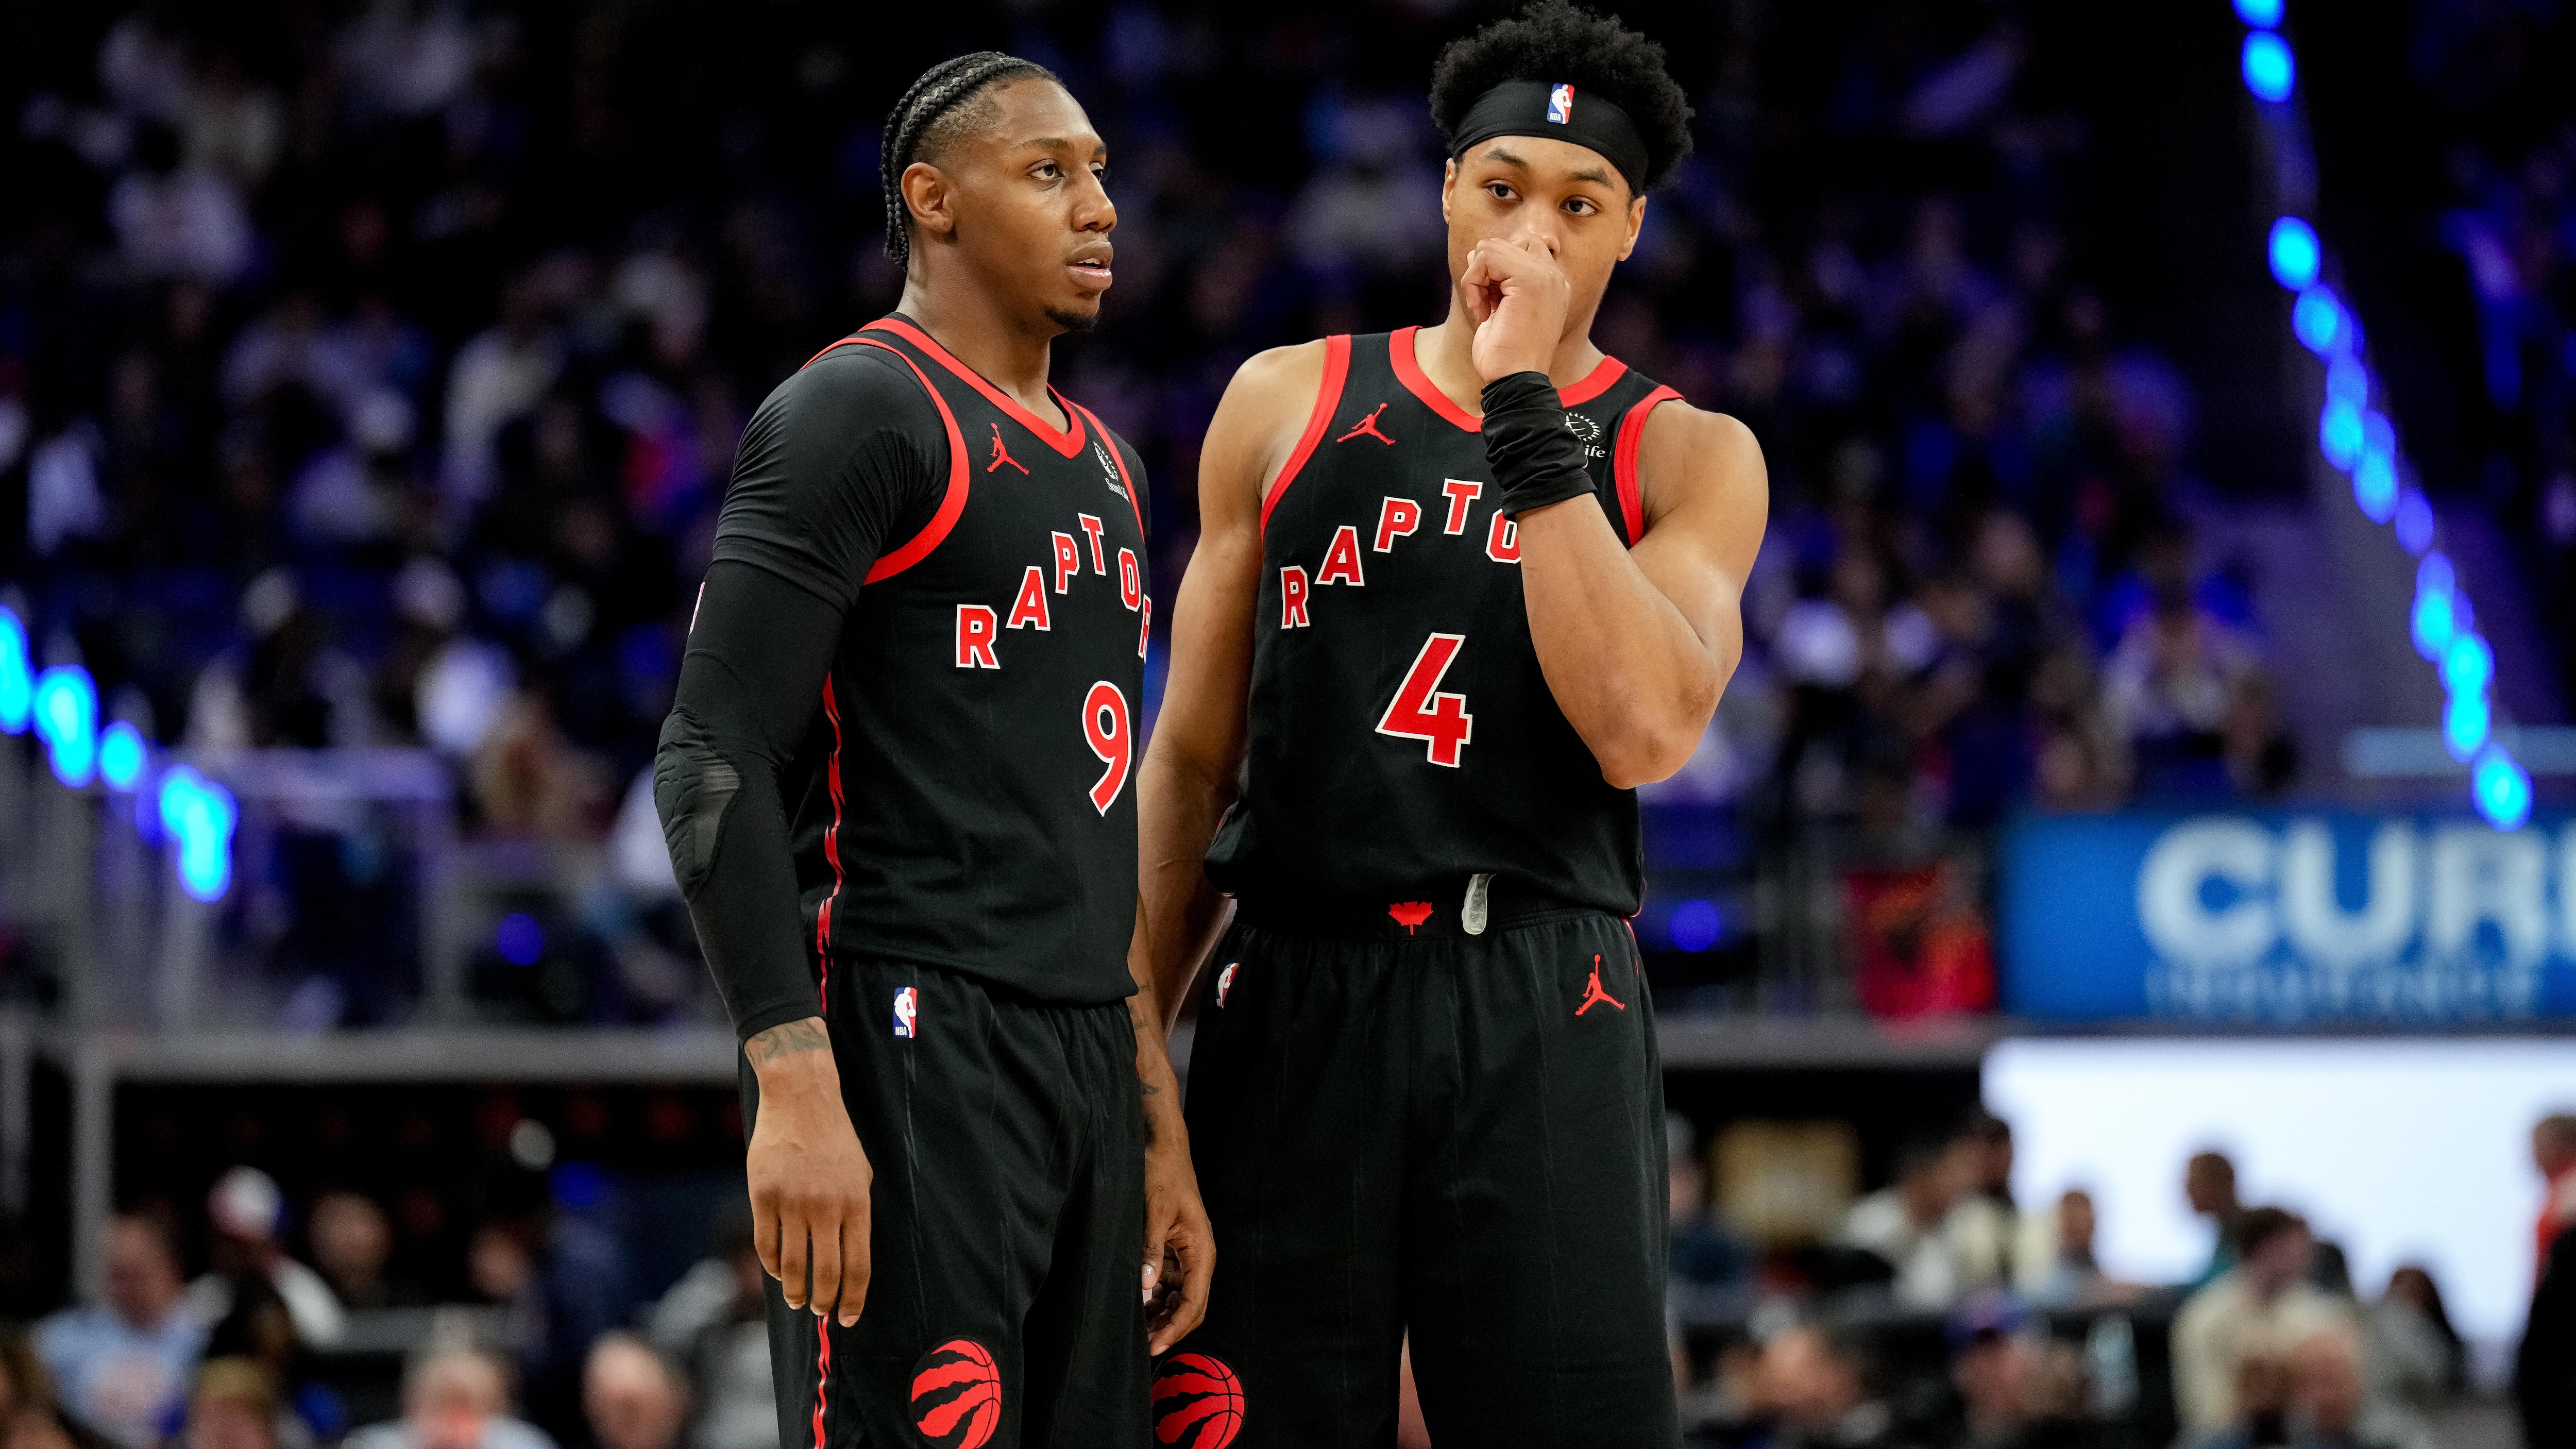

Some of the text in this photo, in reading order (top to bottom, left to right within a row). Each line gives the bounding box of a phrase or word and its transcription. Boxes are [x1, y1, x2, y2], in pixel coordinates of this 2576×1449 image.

[1549, 112, 1561, 121] NBA
[1585, 445, 1606, 458] ife
[1375, 632, 1472, 767] 4
[1082, 680, 1131, 816] 9
[2138, 815, 2576, 963] CUR
[895, 1026, 907, 1036] NBA
